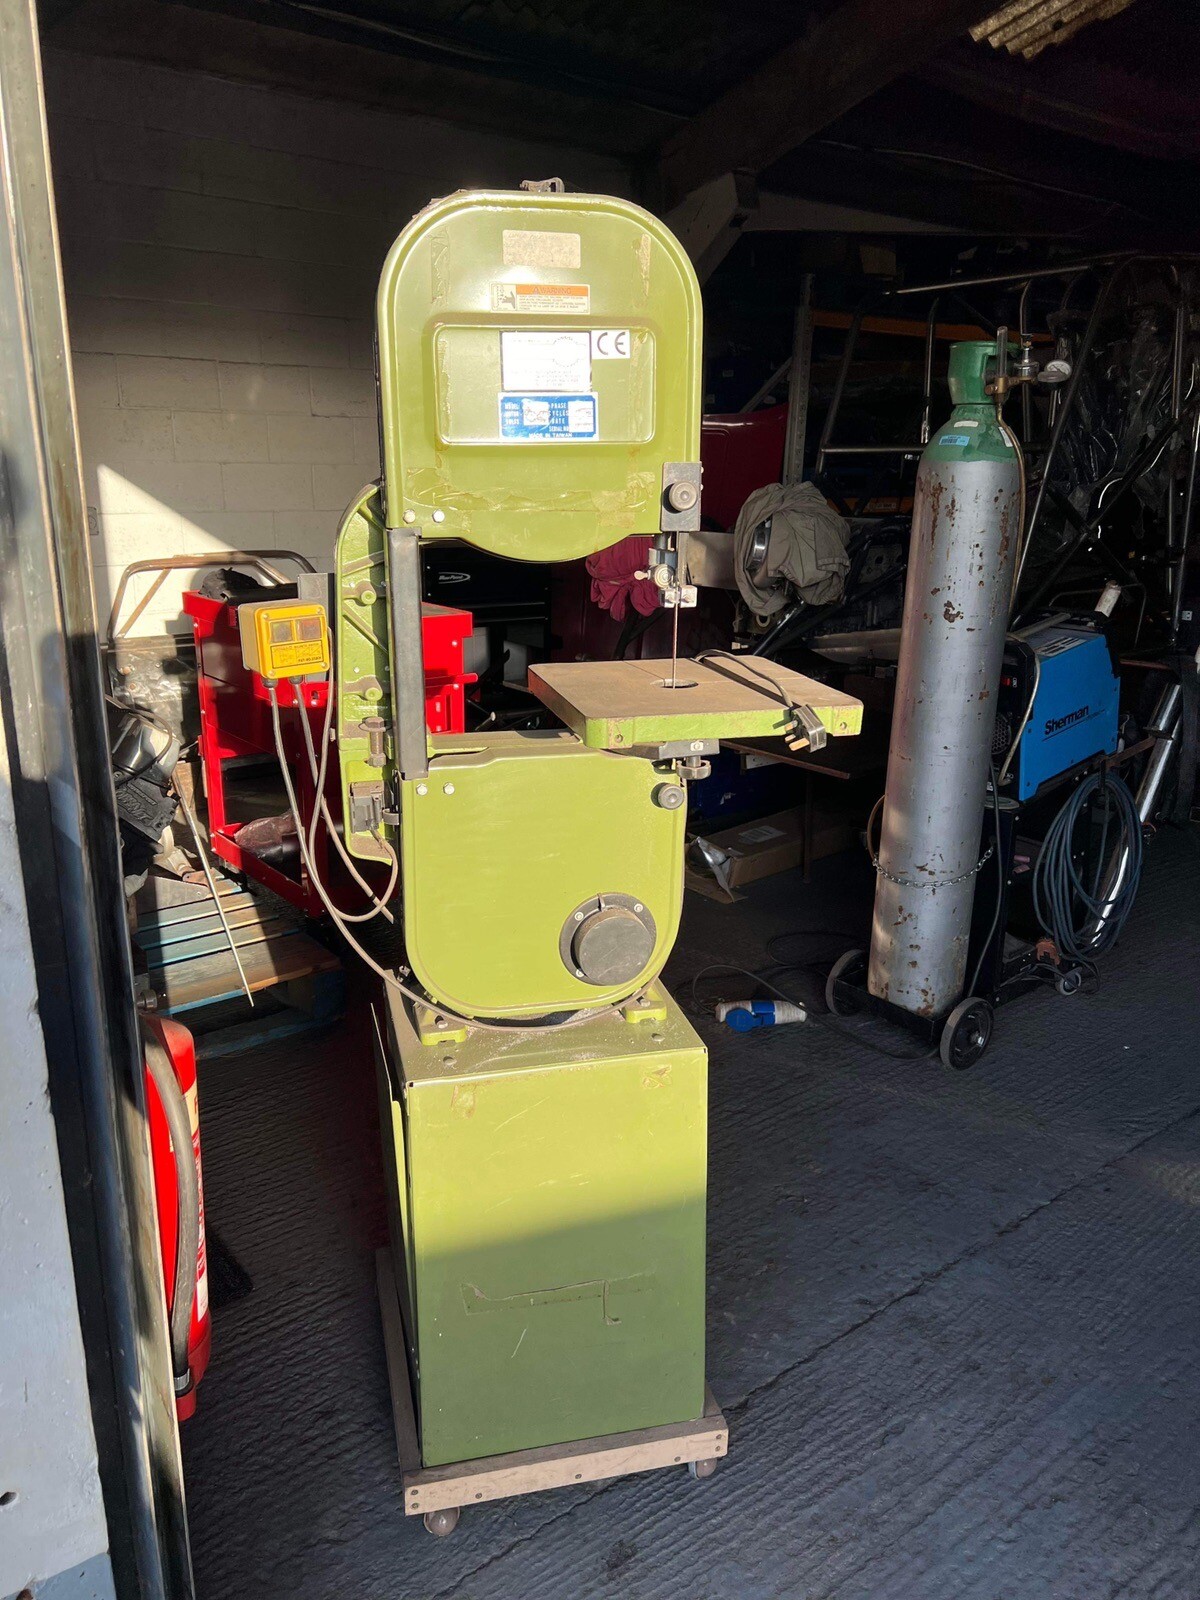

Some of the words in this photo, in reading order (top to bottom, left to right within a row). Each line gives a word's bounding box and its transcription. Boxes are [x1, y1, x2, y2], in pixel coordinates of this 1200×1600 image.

[540, 287, 571, 295] WARNING
[597, 332, 627, 355] CE
[1045, 706, 1089, 735] Sherman
